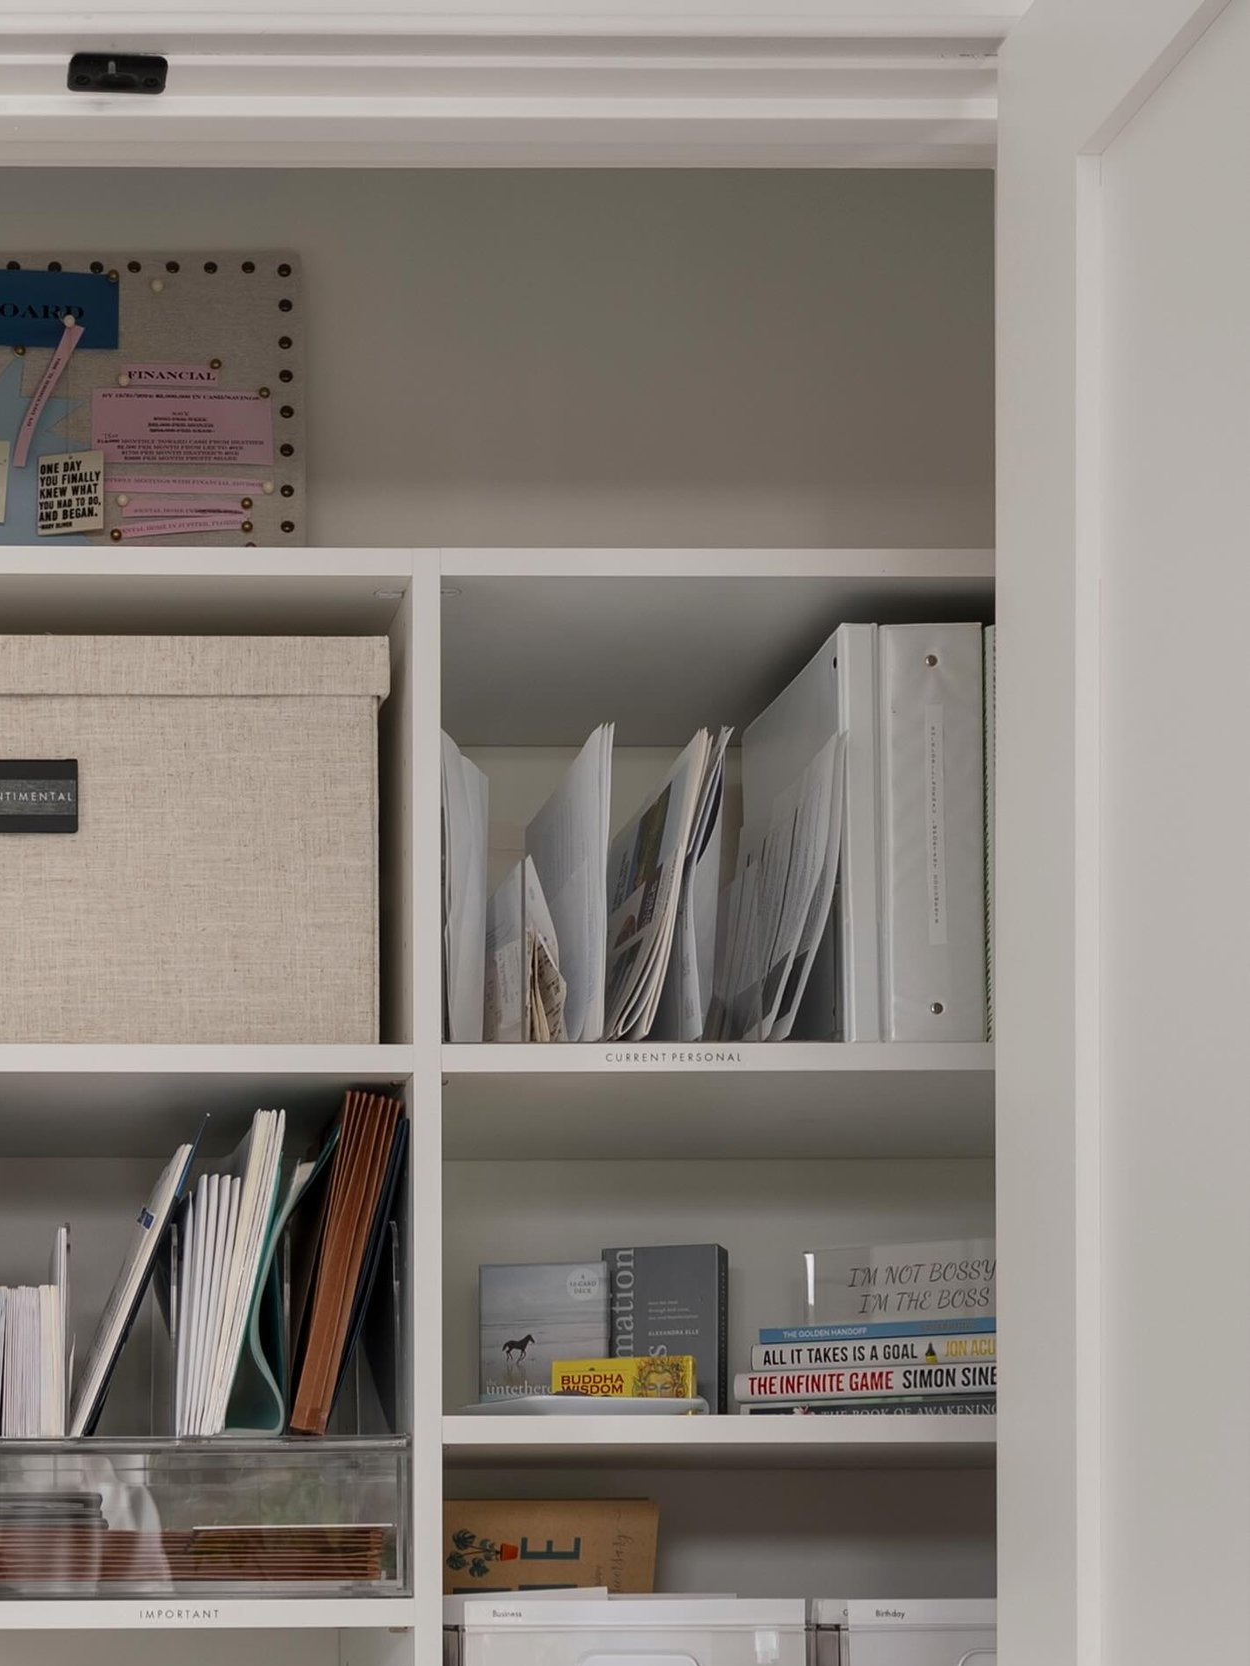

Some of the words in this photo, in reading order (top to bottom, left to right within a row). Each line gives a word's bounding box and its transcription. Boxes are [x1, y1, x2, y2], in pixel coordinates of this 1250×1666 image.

[128, 371, 216, 381] FINANCIAL
[40, 462, 60, 475] ONE
[63, 460, 82, 473] DAY
[40, 475, 58, 487] YOU
[61, 471, 101, 485] FINALLY
[39, 486, 67, 499] KNEW
[71, 483, 98, 496] WHAT
[39, 501, 54, 510] YOU
[57, 499, 73, 509] HAD
[76, 497, 85, 507] TO
[88, 496, 101, 506] DO,
[39, 510, 58, 522] AND
[62, 507, 98, 520] BEGAN.
[605, 1052, 667, 1063] CURRENT
[671, 1052, 742, 1063] PERSONAL
[884, 1263, 926, 1285] NOT
[929, 1259, 996, 1283] BOSSY
[896, 1290, 932, 1311] THE
[937, 1287, 990, 1310] BOSS
[783, 1331, 797, 1339] THE
[798, 1329, 830, 1338] GOLDEN
[831, 1327, 868, 1336] HANDOFF
[763, 1349, 787, 1365] ALL
[790, 1348, 803, 1364] IT
[806, 1345, 848, 1364] TAKES
[853, 1345, 866, 1362] IS
[869, 1344, 879, 1360] A
[883, 1342, 918, 1360] GOAL
[943, 1340, 968, 1358] JON
[561, 1373, 624, 1385] BUDDHA
[748, 1376, 775, 1396] THE
[780, 1373, 845, 1394] INFINITE
[849, 1371, 894, 1391] GAME
[901, 1368, 956, 1389] SIMON
[561, 1384, 623, 1394] WISDOM
[139, 1609, 219, 1620] IMPORTANT
[493, 1609, 523, 1618] Business
[876, 1609, 906, 1620] Birthday
